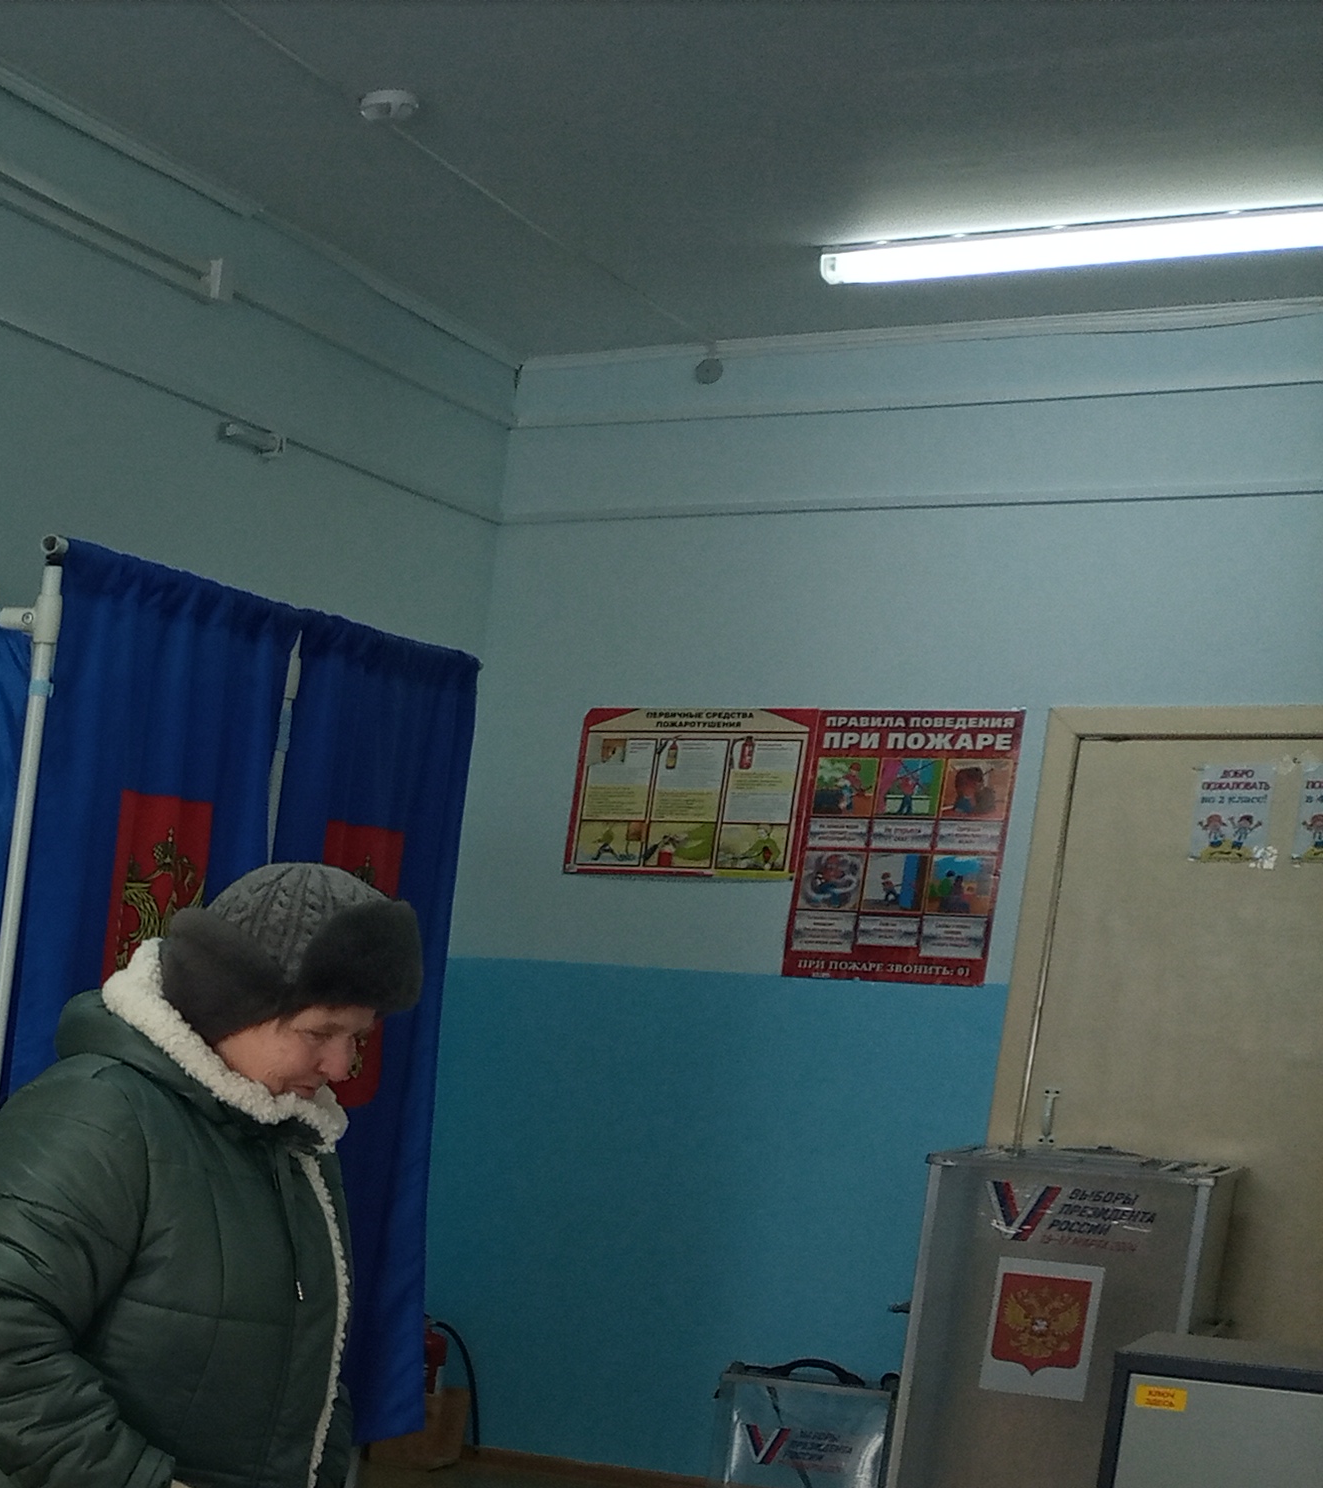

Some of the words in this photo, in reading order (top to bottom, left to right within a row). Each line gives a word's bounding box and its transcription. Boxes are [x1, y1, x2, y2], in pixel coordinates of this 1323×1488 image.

[656, 720, 741, 728] ПОЖАРОТУШЕНИЯ
[826, 716, 905, 726] ПРАВИЛА
[909, 717, 1015, 727] ПОВЕДЕНИЯ
[823, 732, 879, 749] ПРИ
[886, 732, 1012, 750] ПОЖАРЕ
[1220, 769, 1254, 778] ДОБРО
[1201, 781, 1271, 790] ПОЖАЛОВАТЬ
[797, 957, 824, 969] ПРИ
[829, 959, 883, 973] ПОЖАРЕ
[886, 963, 954, 977] ЗВОНИТЬ:
[957, 967, 969, 978] 01
[1068, 1187, 1139, 1206] ВЫБОРЫ
[1058, 1202, 1156, 1224] ПРЕЗИДЕНТА
[1047, 1218, 1112, 1236] РОССИИ
